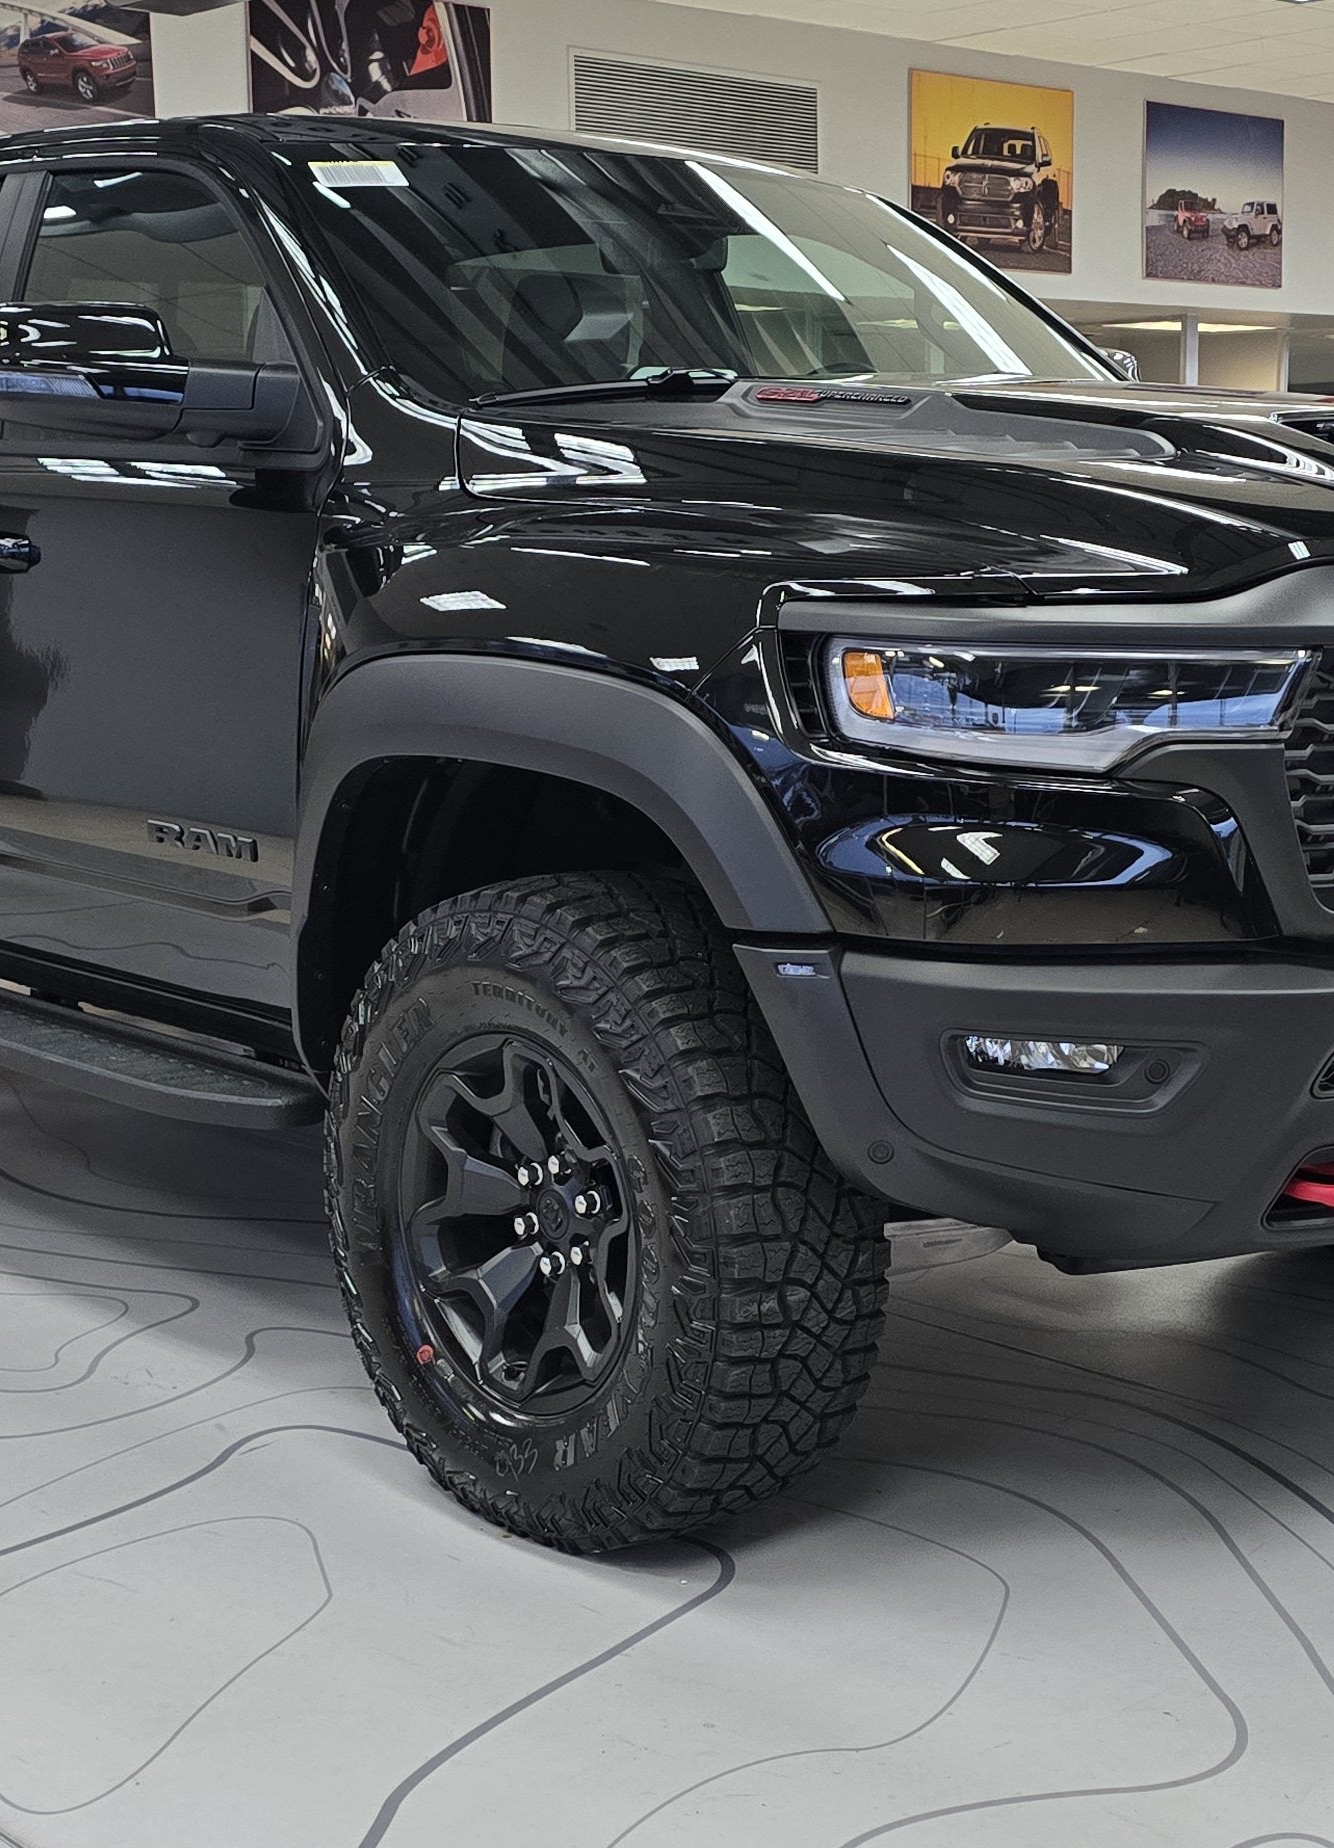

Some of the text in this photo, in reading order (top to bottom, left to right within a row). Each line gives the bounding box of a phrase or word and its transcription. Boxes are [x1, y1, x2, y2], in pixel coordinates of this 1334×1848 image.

[147, 819, 259, 862] RAM
[470, 980, 568, 1038] TERRITORY
[351, 997, 438, 1252] WRANGLER
